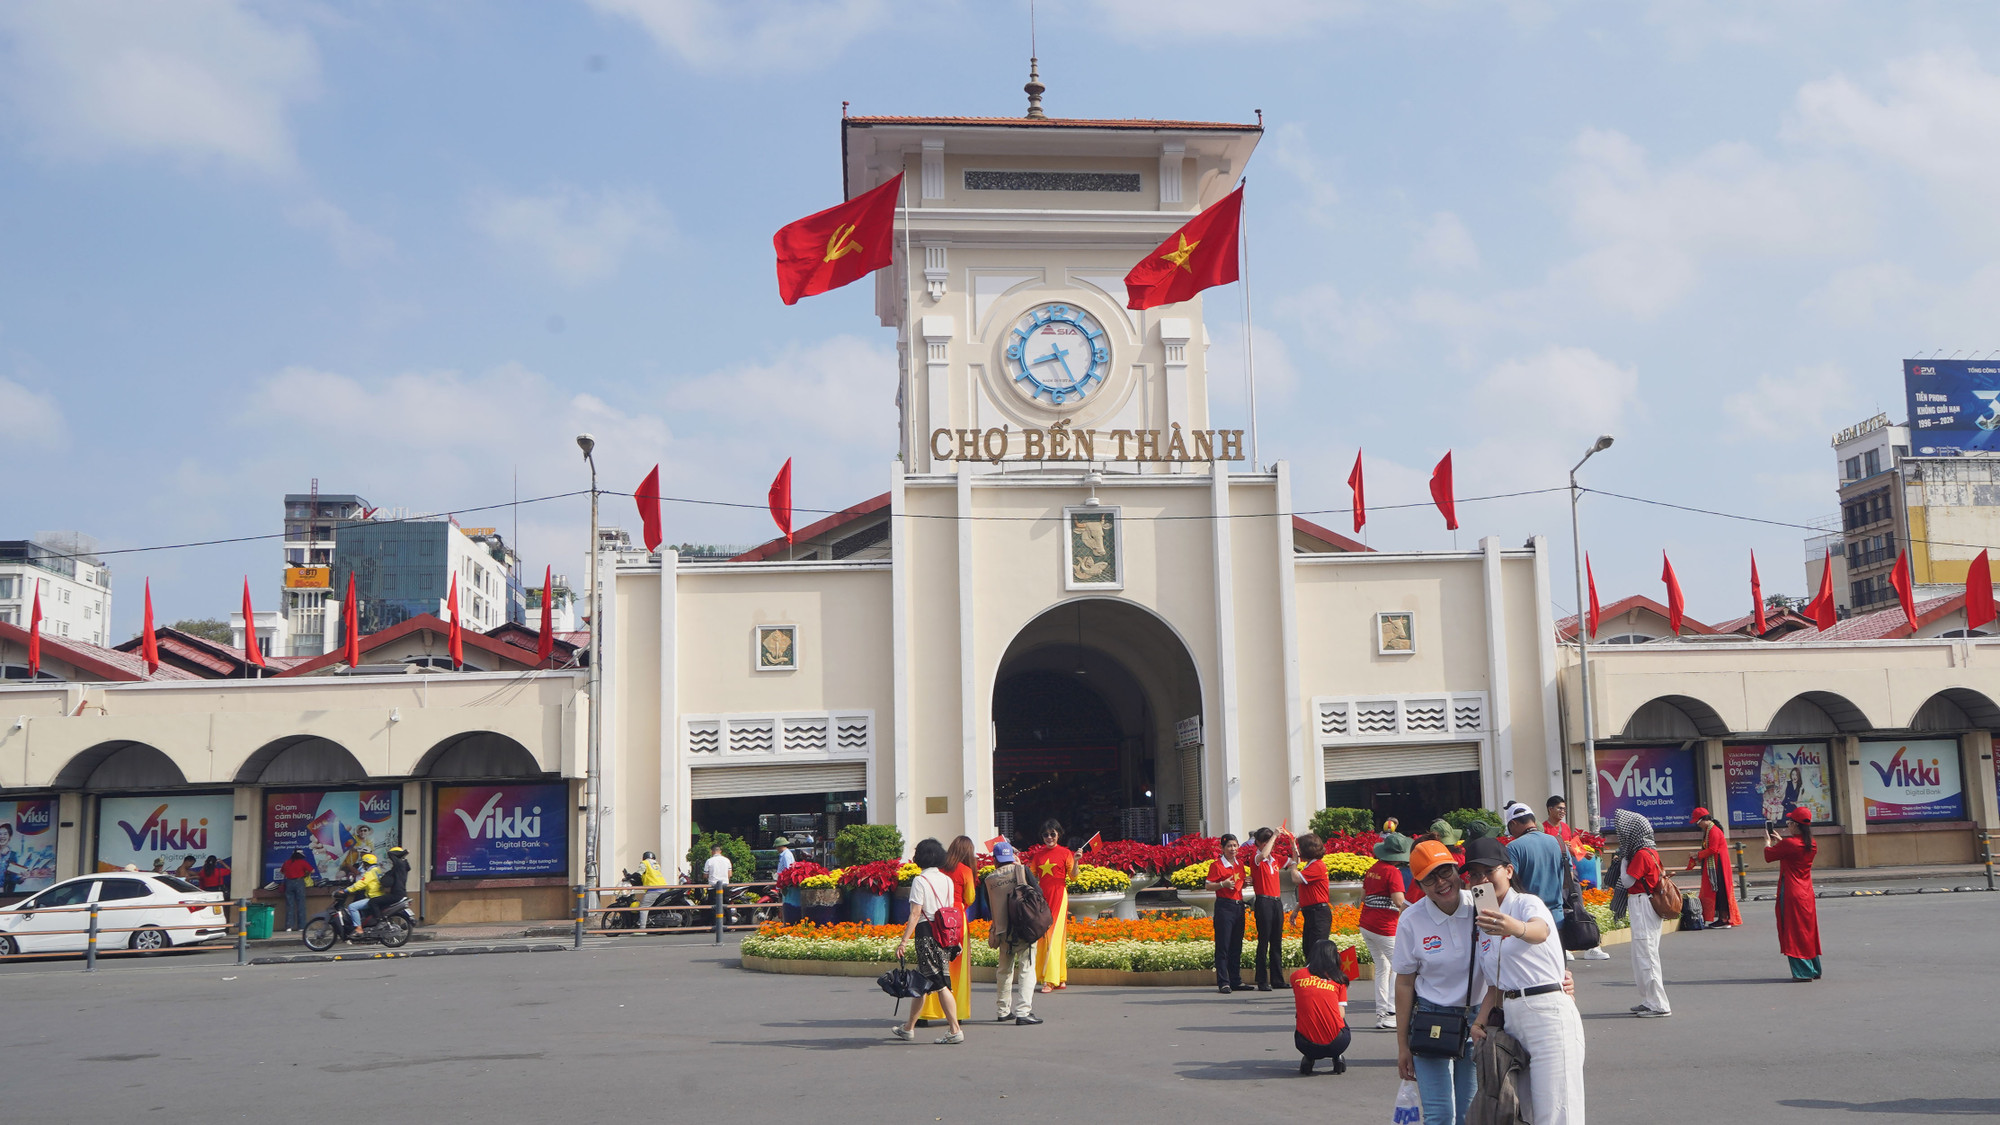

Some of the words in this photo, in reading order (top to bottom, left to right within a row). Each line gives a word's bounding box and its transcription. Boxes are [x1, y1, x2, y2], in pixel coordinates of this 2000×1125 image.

[1047, 305, 1070, 321] 12
[1007, 344, 1021, 360] 9
[1094, 347, 1109, 363] 3
[1051, 388, 1066, 404] 6
[1929, 394, 1947, 402] PHONG
[1917, 404, 1936, 415] KHÔNG
[931, 424, 1009, 465] CHỢ
[1022, 418, 1096, 461] BẾN
[1110, 422, 1245, 461] THÀNH
[348, 507, 409, 519] AVANTI
[1787, 746, 1820, 765] Vikki
[1729, 768, 1743, 776] 0%
[1869, 746, 1940, 787] Vikki
[1599, 754, 1673, 797] Vikki
[361, 795, 389, 811] Vikki
[1636, 799, 1658, 807] Digital
[18, 806, 48, 823] Vikki
[275, 812, 291, 820] cảm
[454, 792, 541, 839] Vikki
[117, 804, 208, 851] Vikki
[274, 830, 296, 838] tương
[495, 841, 520, 849] Digital
